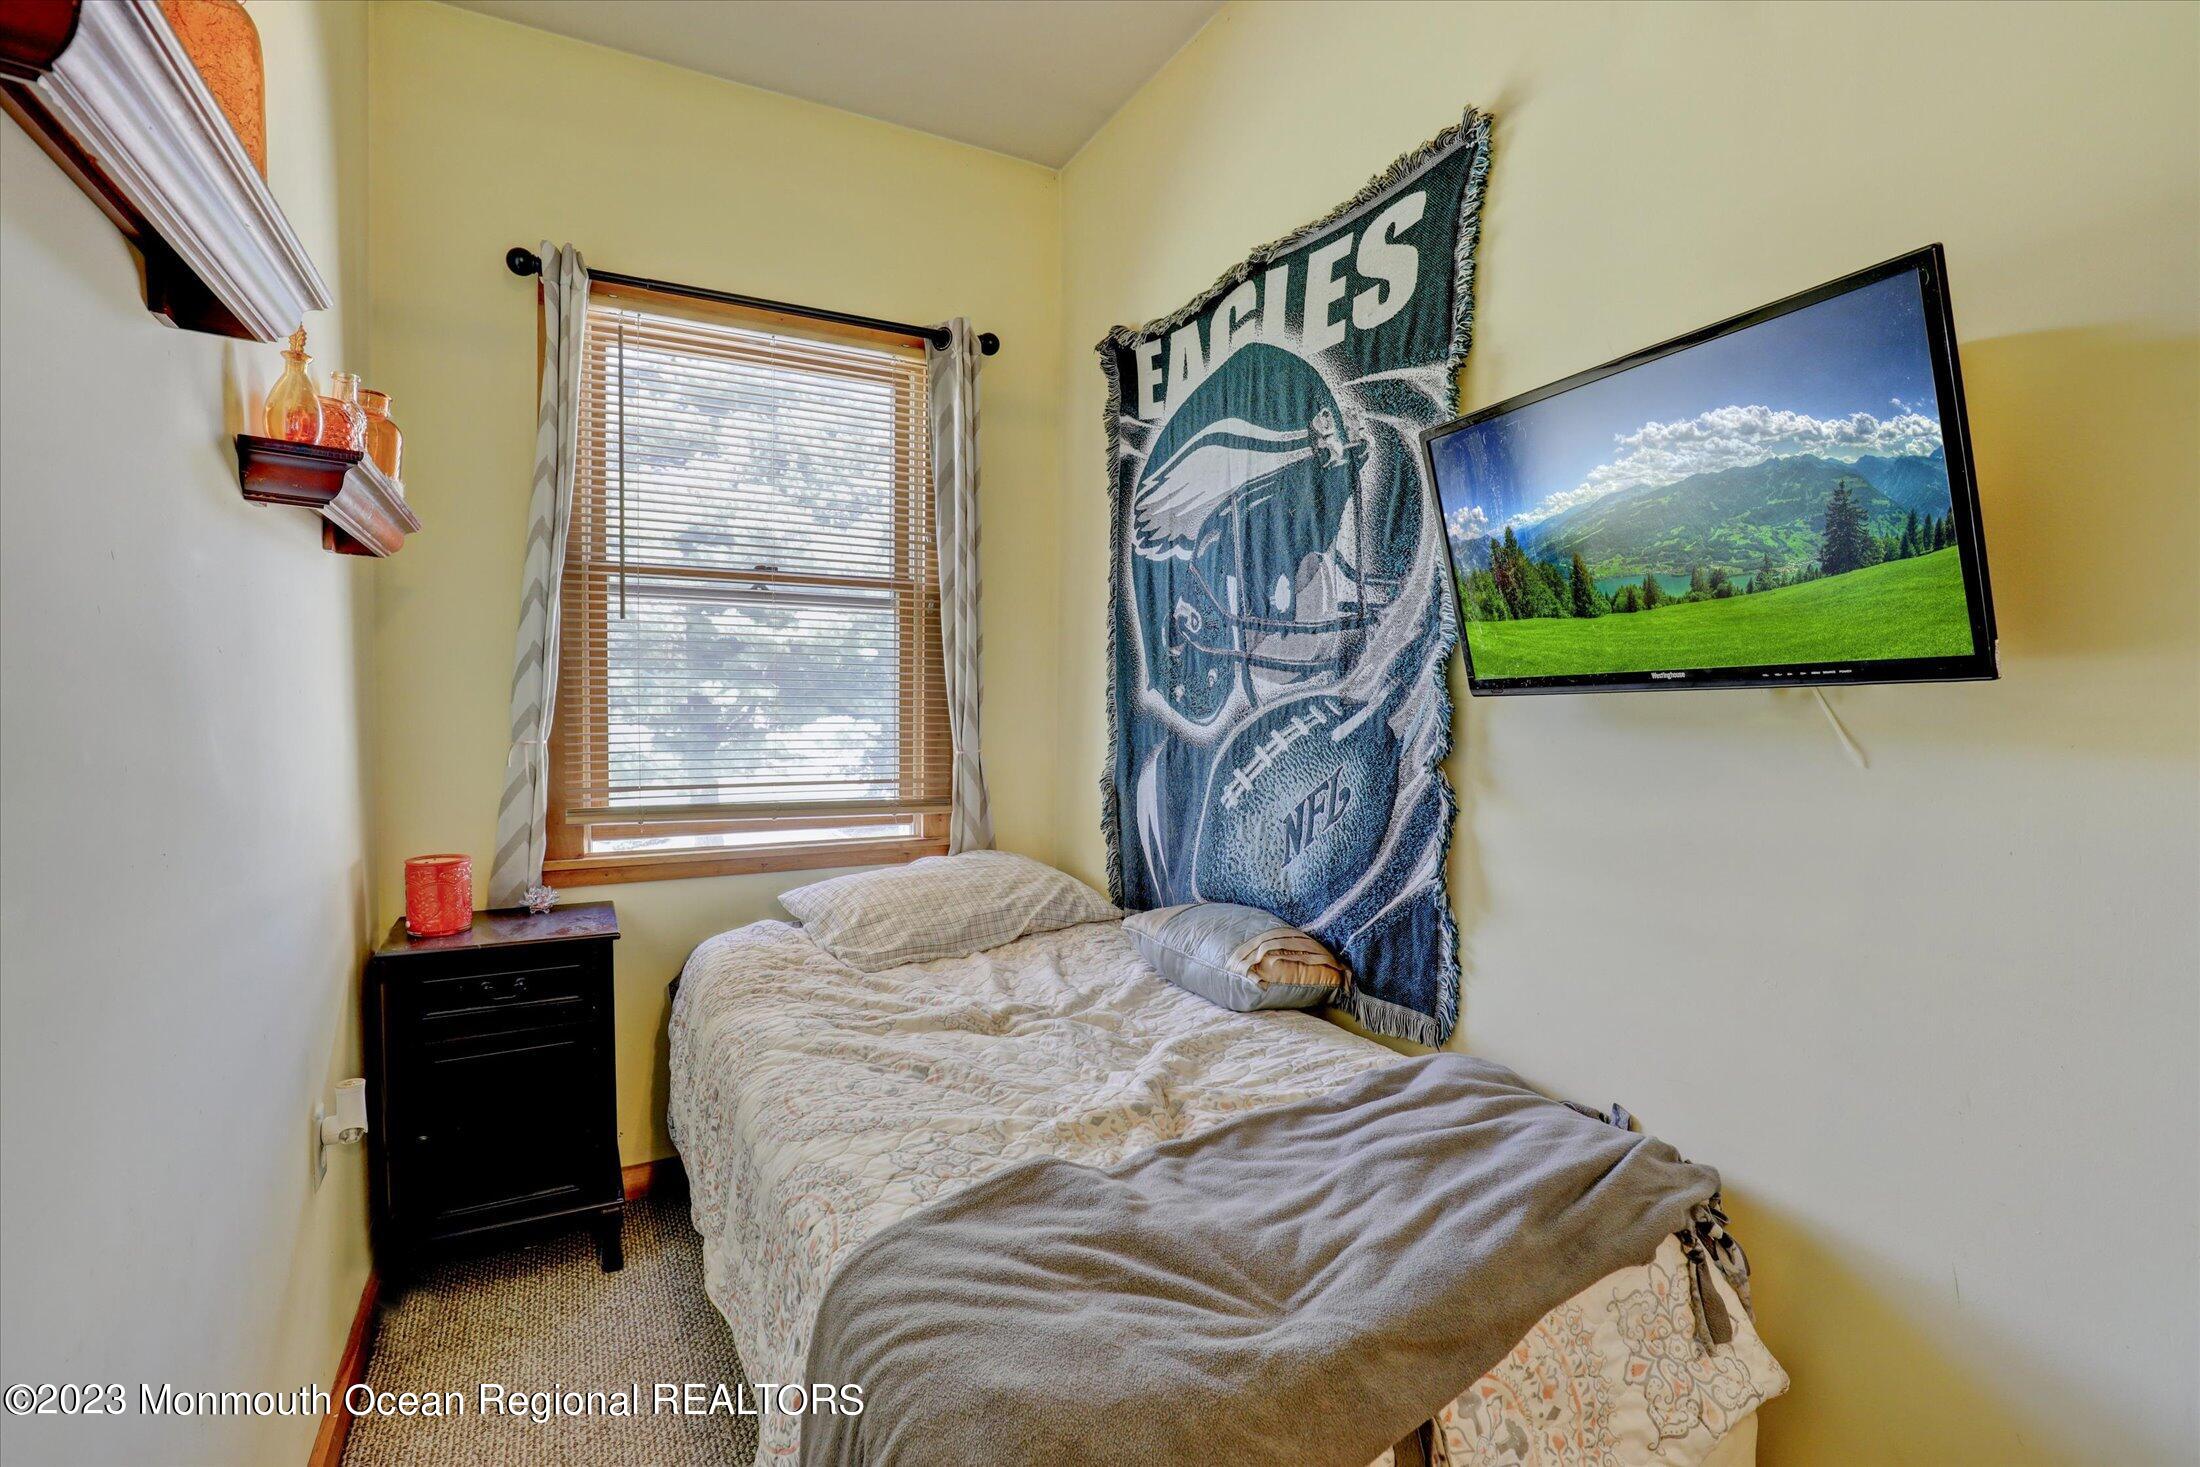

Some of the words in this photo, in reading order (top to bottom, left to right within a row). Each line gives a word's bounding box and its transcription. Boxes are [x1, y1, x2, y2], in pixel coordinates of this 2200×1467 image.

[1135, 190, 1427, 420] EAGLES
[1650, 671, 1686, 680] Westinghouse
[1280, 765, 1351, 869] NFL
